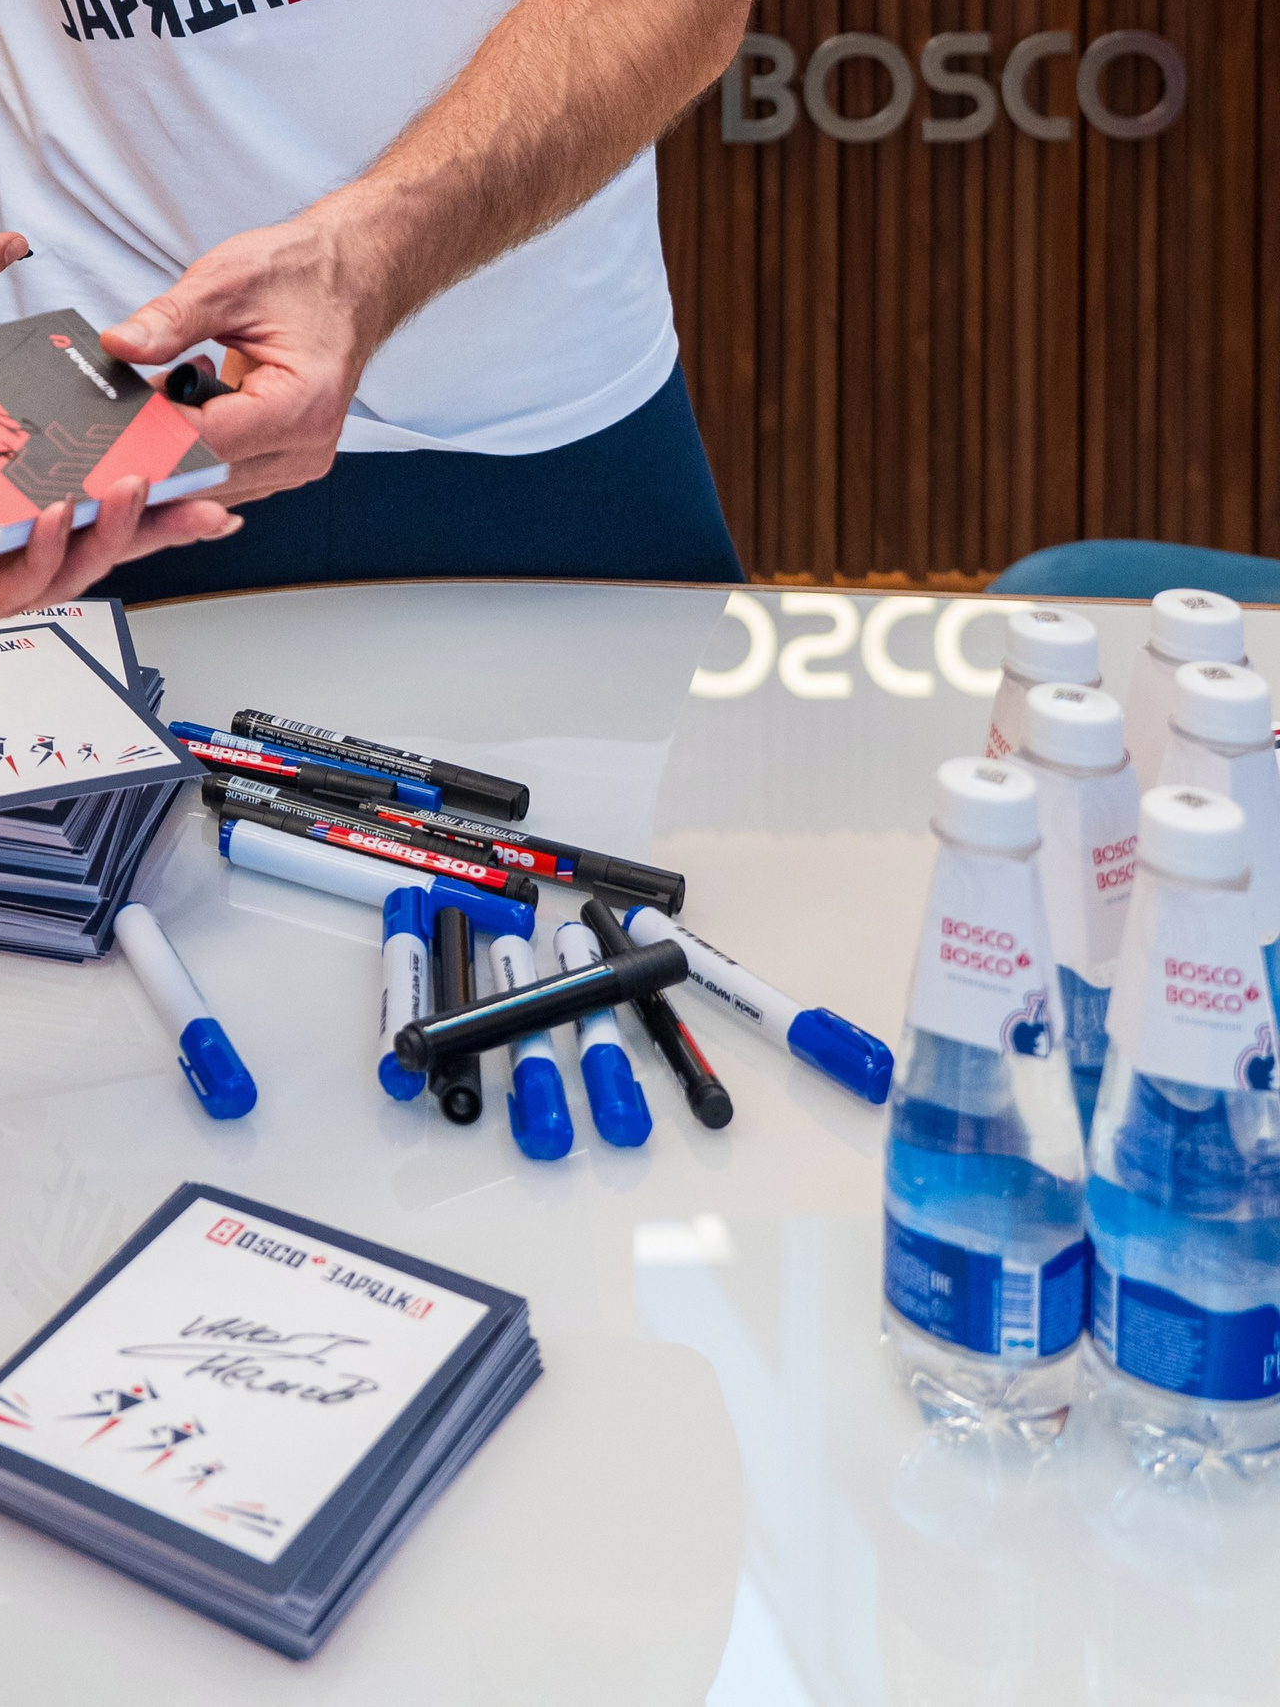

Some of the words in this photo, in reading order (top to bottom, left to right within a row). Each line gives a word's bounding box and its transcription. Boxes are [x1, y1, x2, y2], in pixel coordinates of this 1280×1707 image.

[721, 29, 1186, 143] BOSCO
[17, 607, 83, 617] РЯДКА
[188, 740, 262, 763] edding
[413, 808, 458, 829] marker
[457, 818, 531, 843] permanent
[348, 832, 427, 863] edding
[433, 853, 487, 878] 300
[941, 917, 1015, 952] BOSCO
[940, 942, 1014, 979] BOSCO
[1164, 957, 1243, 988] BOSCO
[704, 980, 731, 1003] МАРКЕР
[1165, 984, 1243, 1015] BOSCO
[205, 1216, 308, 1270] BOSCO
[322, 1262, 434, 1321] ЗАРЯДКА
